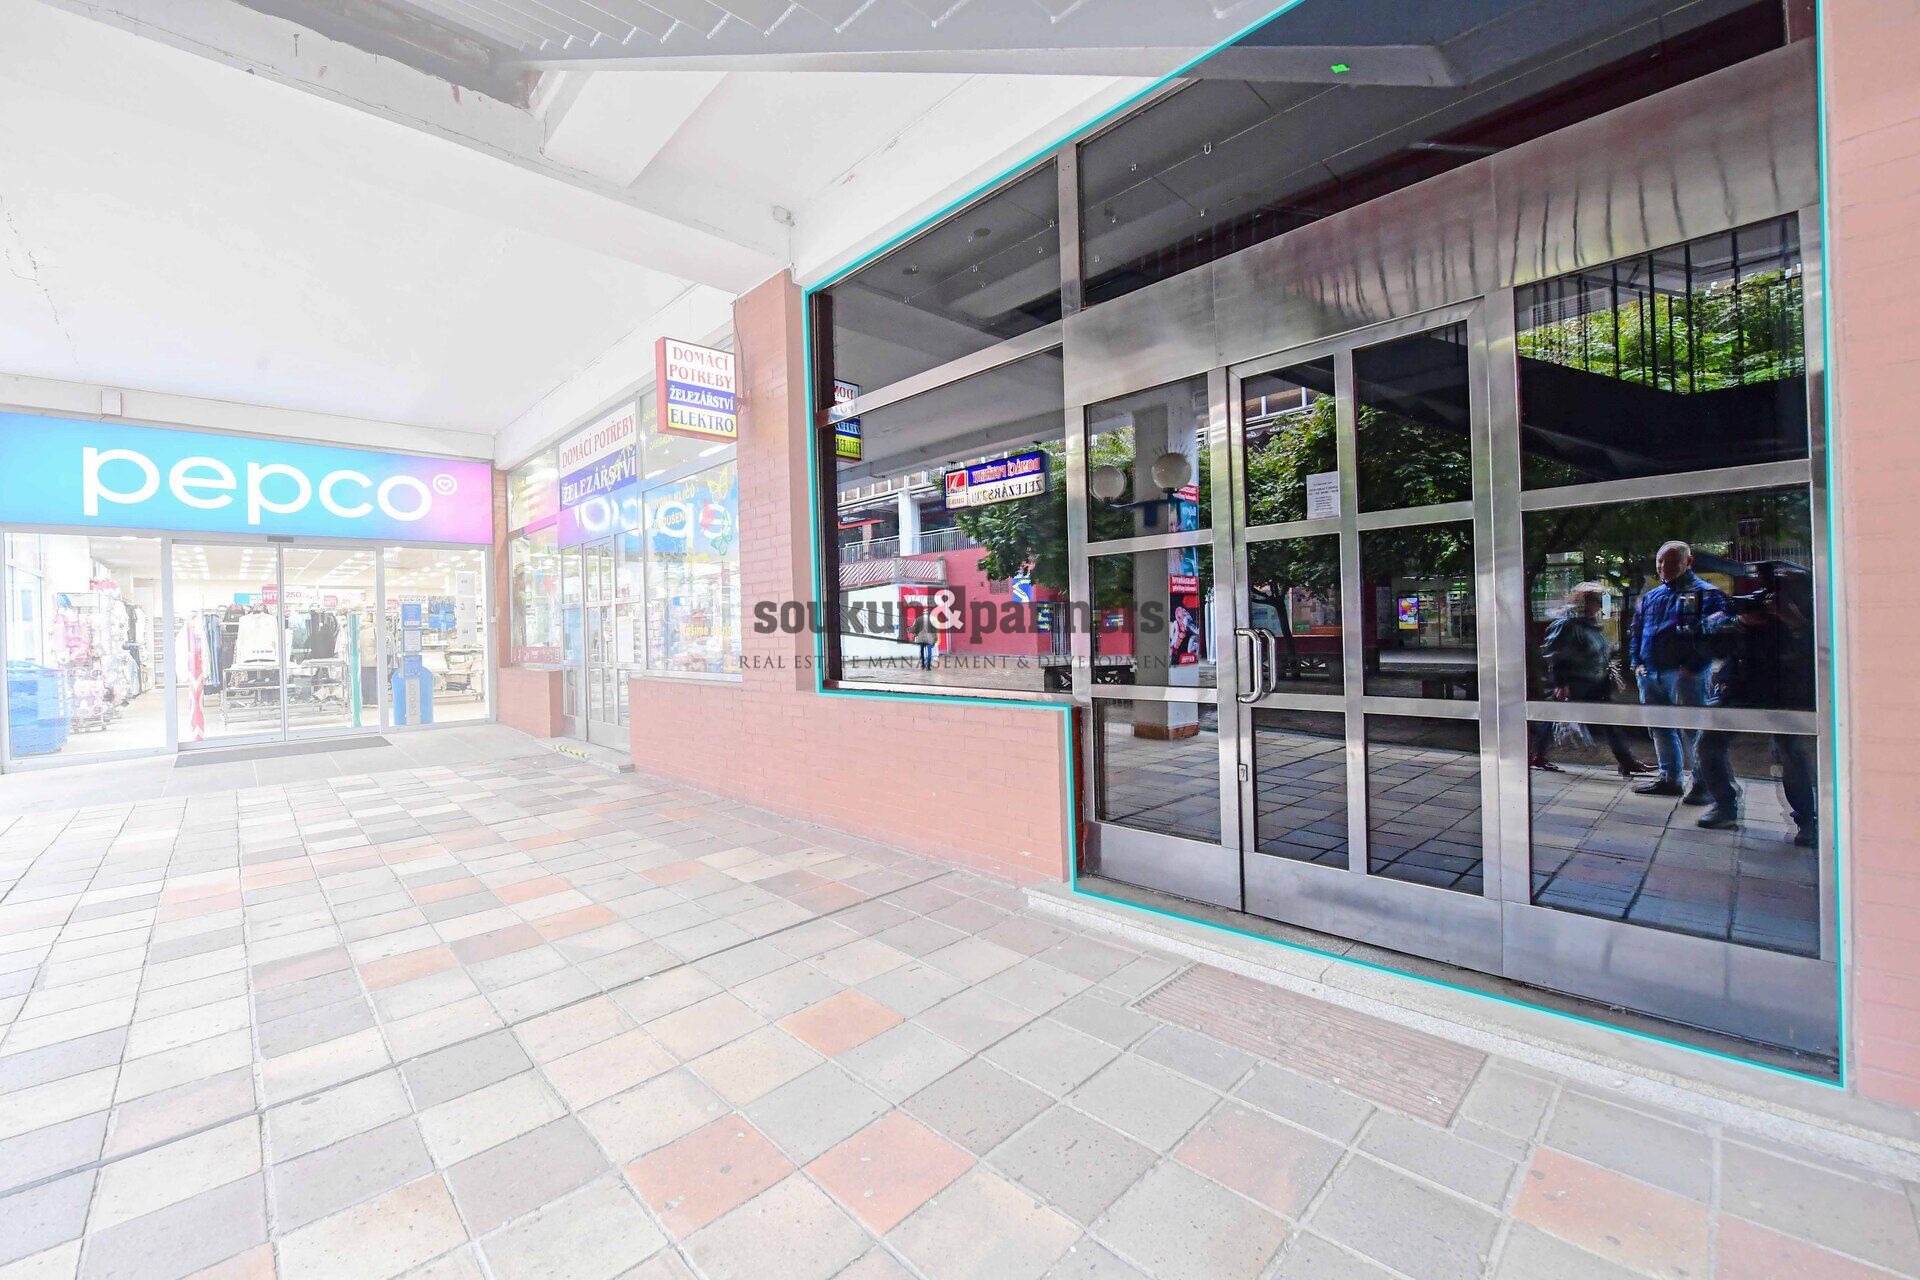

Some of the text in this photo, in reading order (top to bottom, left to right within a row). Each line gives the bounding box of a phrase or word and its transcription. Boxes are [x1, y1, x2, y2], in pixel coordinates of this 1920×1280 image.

[673, 347, 728, 371] DOMÁCÍ
[669, 385, 734, 411] ŽELEZÁŘSTVÍ
[671, 409, 734, 433] ELEKTRO
[562, 432, 592, 469] DOMÁCÍ
[594, 413, 635, 452] POTŘEBY
[83, 446, 433, 525] pepco
